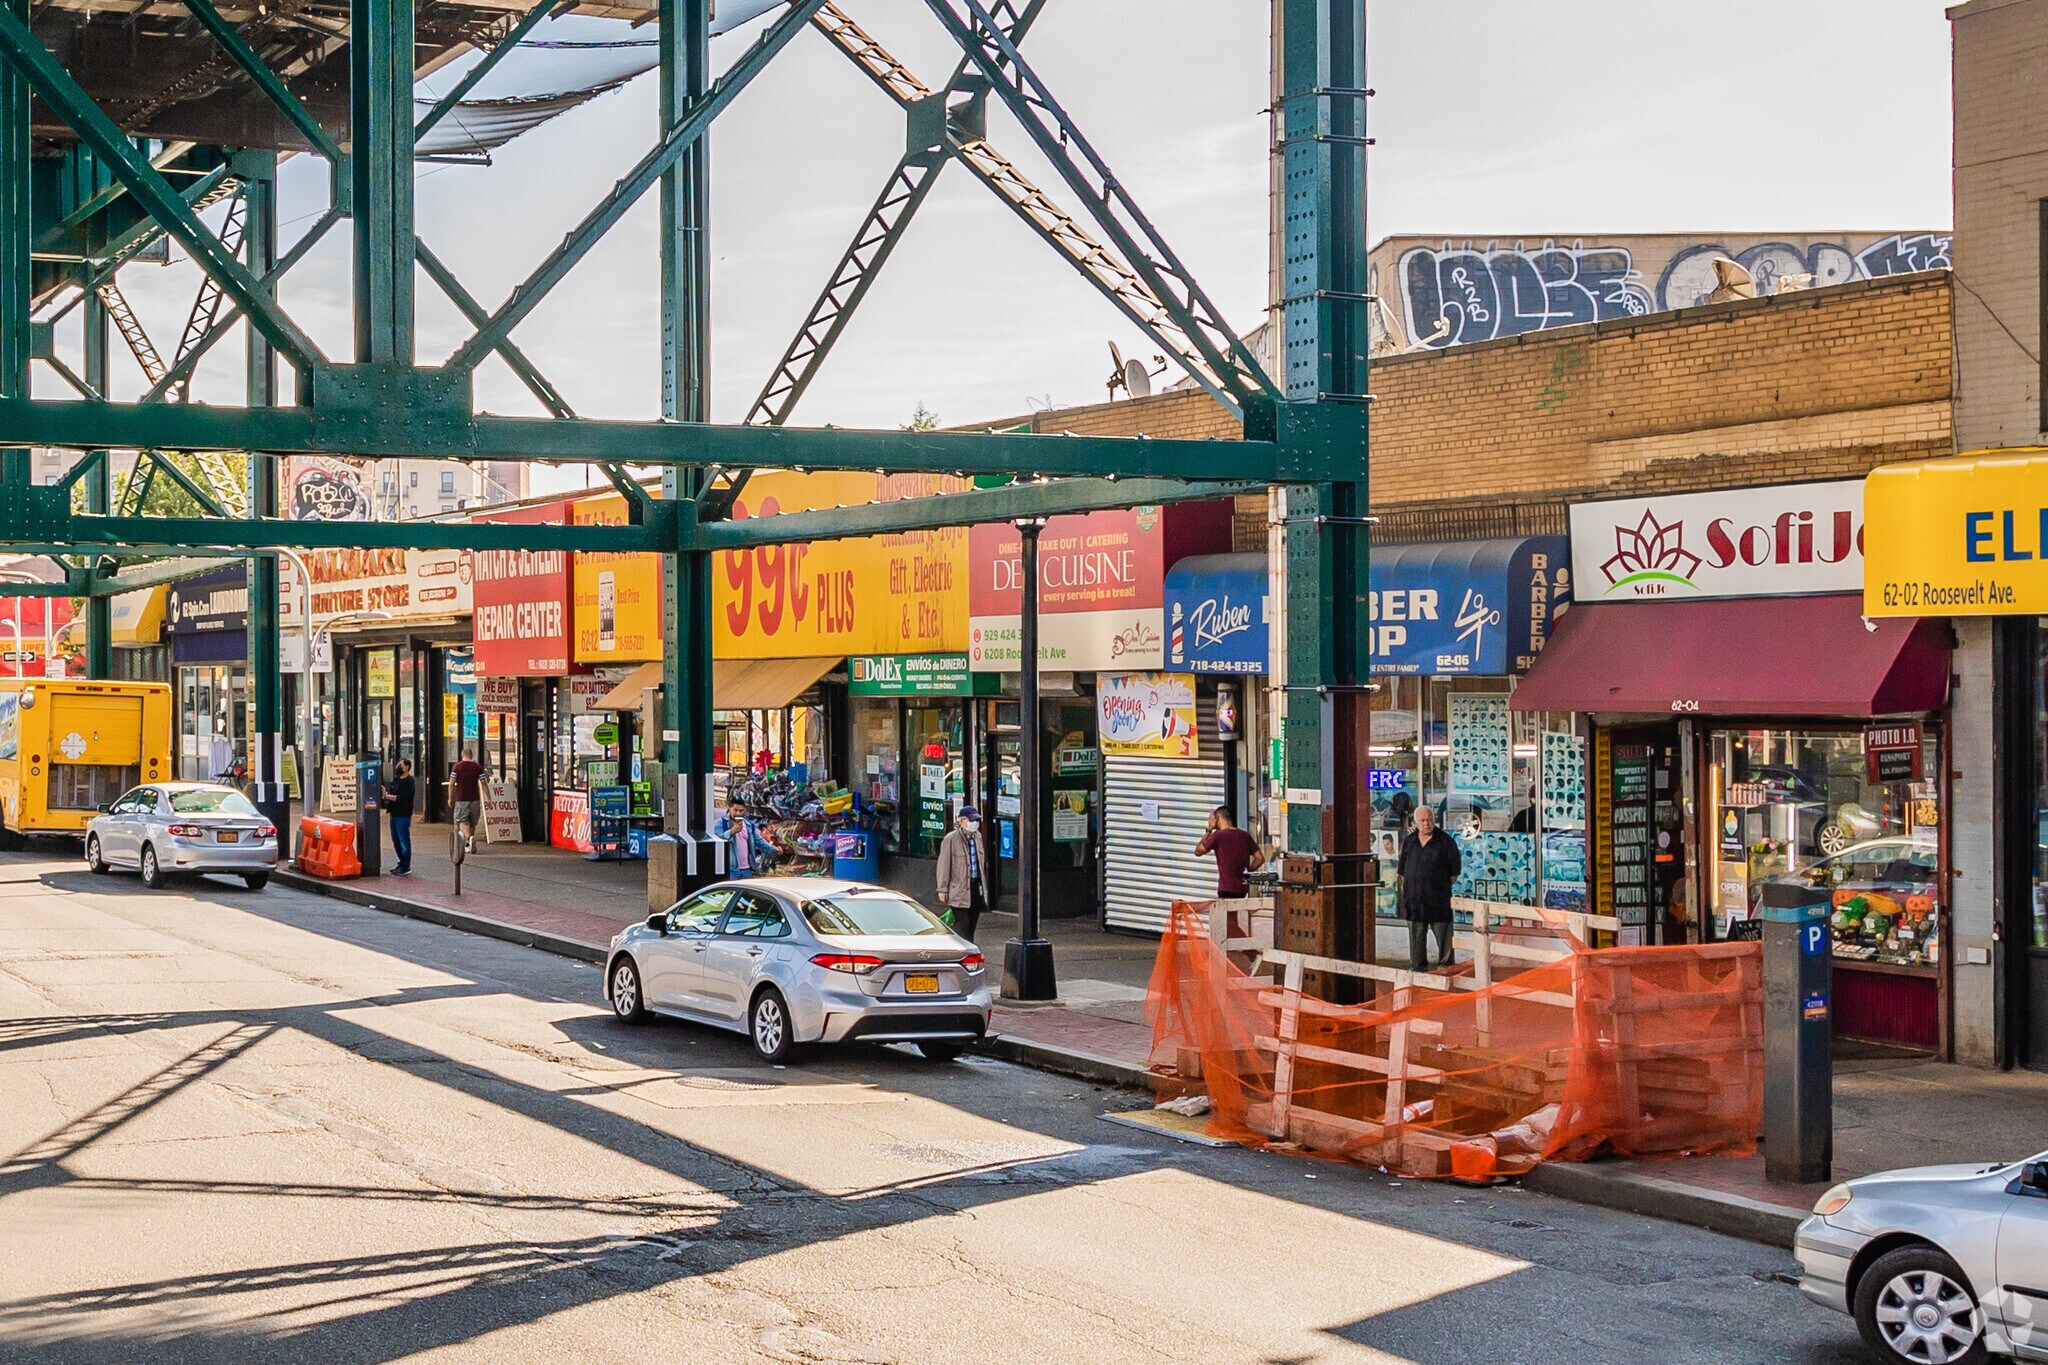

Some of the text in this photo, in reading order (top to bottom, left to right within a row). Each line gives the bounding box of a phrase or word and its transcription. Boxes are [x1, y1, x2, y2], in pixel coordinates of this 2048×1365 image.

[1039, 540, 1059, 551] TAKE
[1060, 538, 1077, 550] OUT
[1087, 533, 1129, 548] CATERING
[1706, 510, 1864, 569] SofiJ
[890, 553, 952, 598] Gift, Electric
[993, 549, 1136, 590] DE CUISINE
[367, 583, 409, 612] STORE
[1043, 586, 1136, 603] every serving is a treat!
[1884, 579, 2017, 606] 62-02 Roosevelt Ave.
[817, 570, 854, 634] PLUS
[1530, 553, 1548, 652] BARBER
[477, 600, 562, 641] REPAIR CENTER
[901, 601, 940, 640] & Etc.
[1189, 595, 1251, 650] Ruben
[984, 630, 999, 641] 929
[1001, 629, 1016, 640] 424
[984, 648, 1004, 660] 6208
[1050, 647, 1066, 659] Ave
[1436, 655, 1470, 666] 62-06
[864, 656, 967, 682] DolEx ENVÍOS de DINERO
[1190, 660, 1263, 673] 718-424-8325
[372, 685, 390, 694] DEALER
[484, 681, 514, 693] WE BUY
[1103, 695, 1146, 720] Opening
[1671, 699, 1700, 711] 62-04
[1112, 709, 1139, 734] Soon
[1868, 729, 1900, 745] PHOTO
[924, 743, 944, 758] OPEN
[1073, 751, 1097, 762] DolE
[367, 769, 375, 780] P
[493, 786, 504, 796] WE
[484, 800, 517, 811] BUY GOLD
[922, 820, 944, 830] DINERO
[1720, 882, 1744, 893] OPEN
[1808, 926, 1821, 952] P
